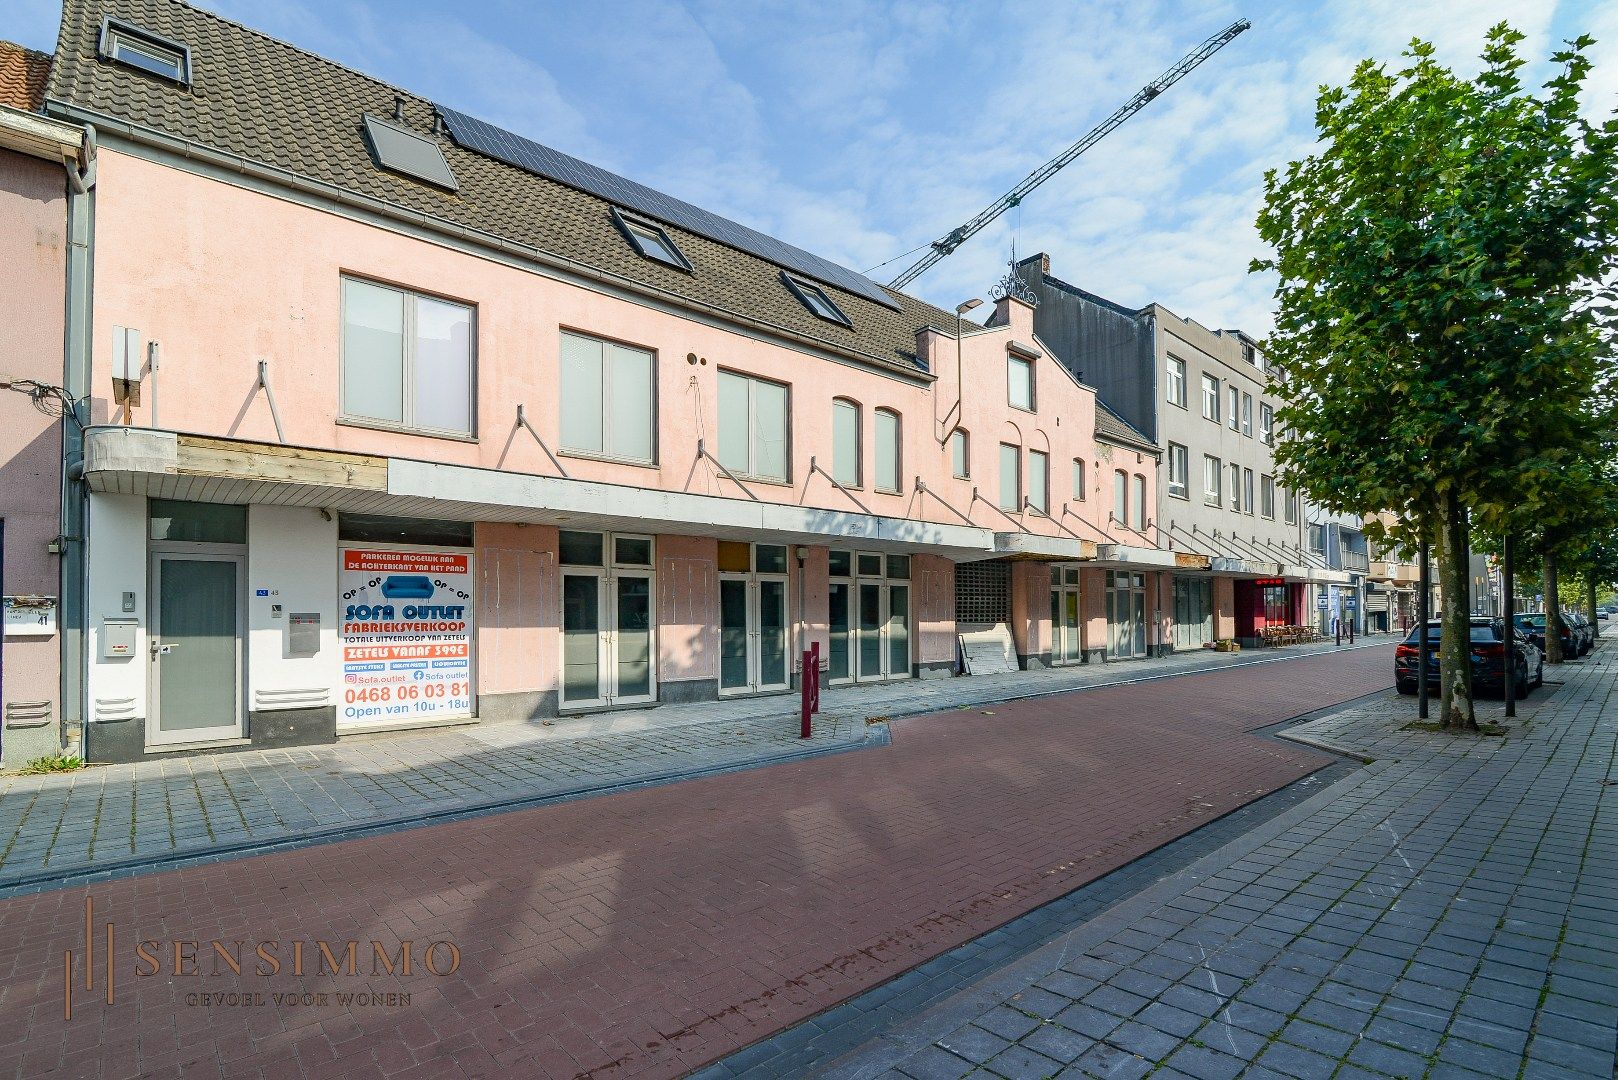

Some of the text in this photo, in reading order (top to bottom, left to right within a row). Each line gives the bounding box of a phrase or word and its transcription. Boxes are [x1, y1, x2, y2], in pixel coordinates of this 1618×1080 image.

[343, 589, 356, 600] OP
[368, 577, 382, 588] OP
[434, 580, 447, 588] OP
[457, 591, 469, 600] OP
[346, 605, 464, 620] SOFA OUTLET
[38, 616, 47, 625] 41
[344, 622, 466, 633] FABRIEKSVERKOOP
[348, 648, 388, 658] ZETELS
[392, 646, 431, 656] VANAF
[358, 675, 405, 684] Sofa.outlet
[345, 682, 468, 703] 0468 06 03 81
[345, 706, 381, 719] Open
[386, 705, 409, 714] van
[414, 702, 435, 711] 10u
[448, 700, 468, 708] 18u
